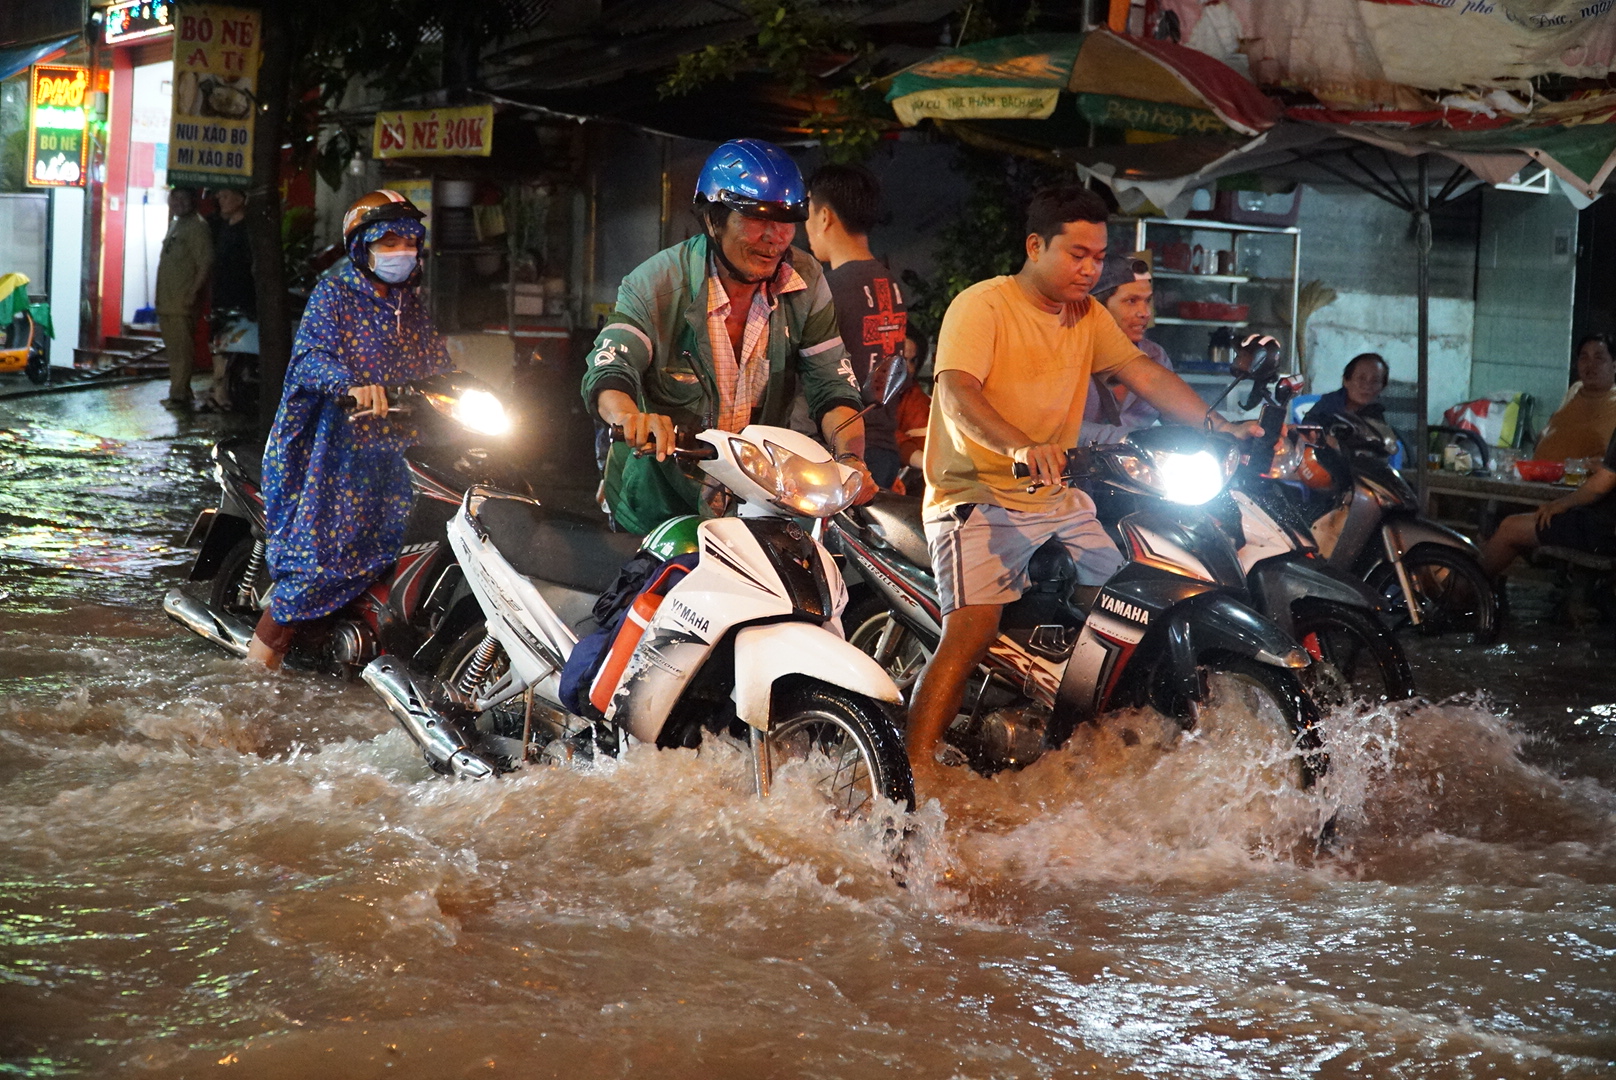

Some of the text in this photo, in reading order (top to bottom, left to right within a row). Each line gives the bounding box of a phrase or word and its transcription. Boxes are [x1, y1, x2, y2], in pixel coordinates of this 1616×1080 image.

[181, 10, 213, 43] BÒ
[221, 15, 252, 47] NÉ
[187, 48, 209, 68] A
[40, 132, 77, 151] BÒ NÉ
[177, 123, 247, 145] NUI XÀO BÒ
[379, 112, 484, 150] BÒ NÉ 30K
[198, 147, 222, 167] XÀO
[226, 149, 243, 168] BÒ
[857, 555, 919, 608] SIRIUS RC
[671, 598, 710, 634] YAMAHA
[1100, 593, 1149, 625] YAMAHA
